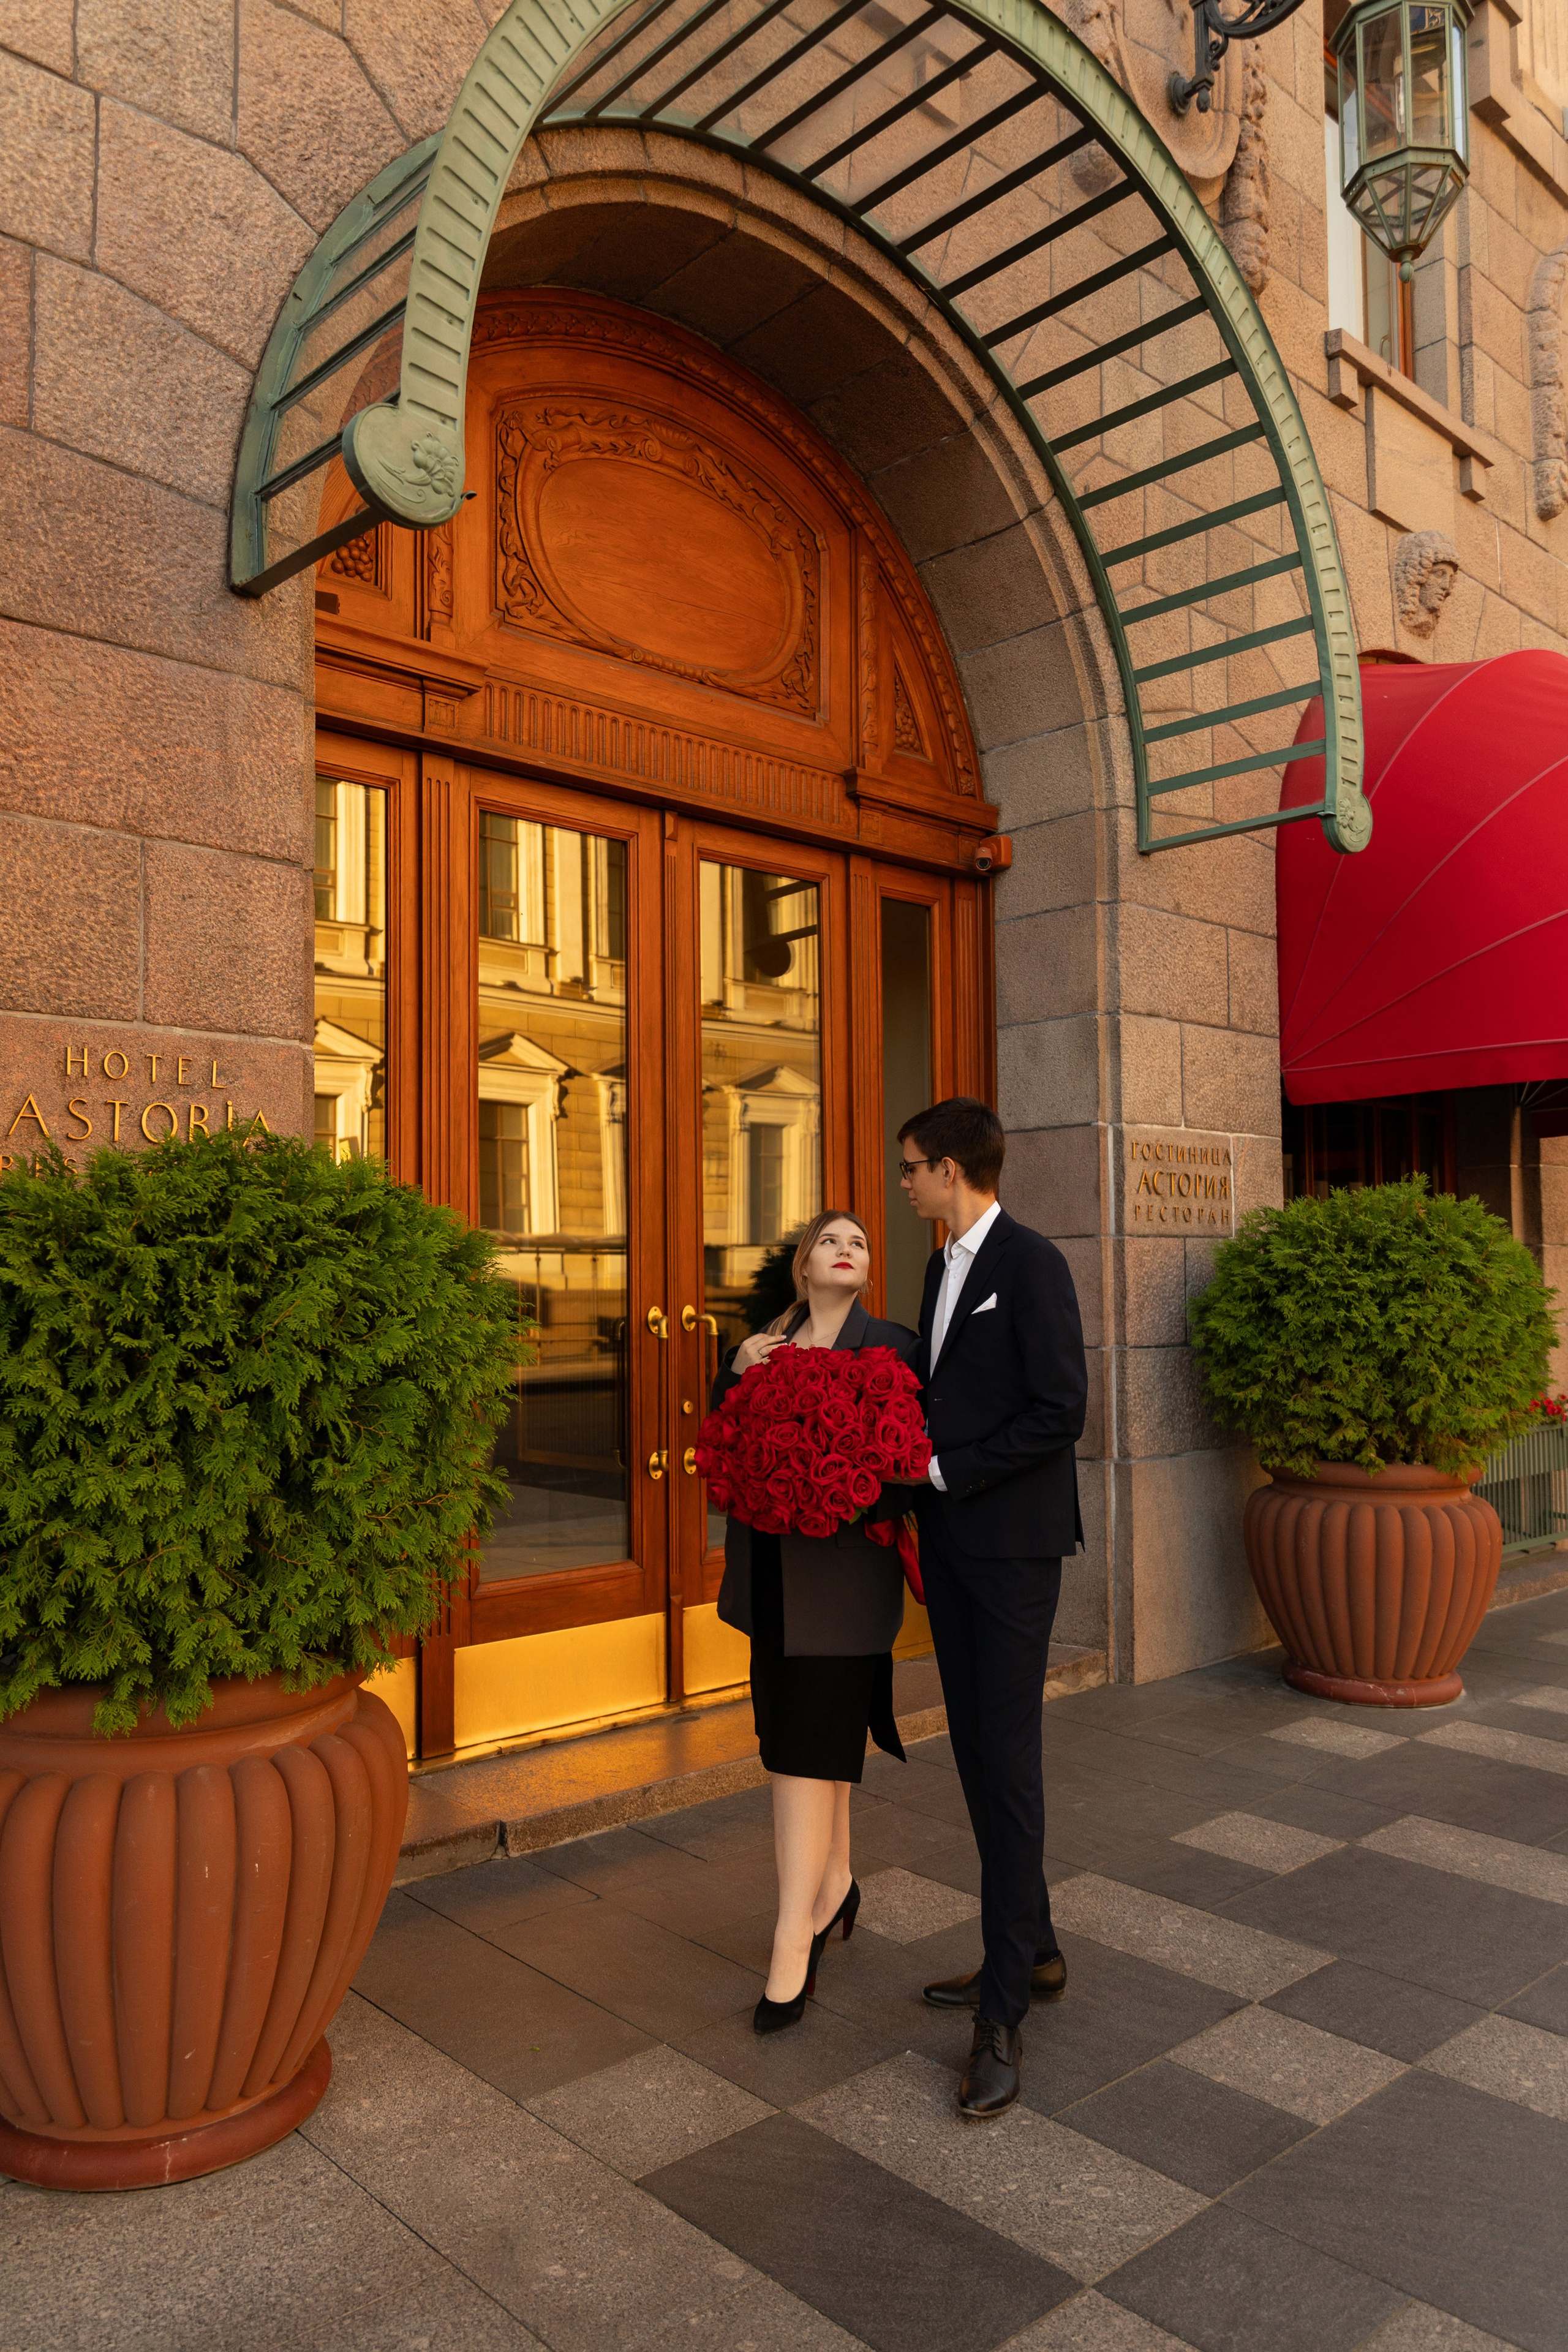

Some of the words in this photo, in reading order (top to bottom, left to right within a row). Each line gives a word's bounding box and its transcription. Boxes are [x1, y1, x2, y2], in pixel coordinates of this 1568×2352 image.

[66, 1046, 228, 1089] HOTEL
[1131, 1141, 1232, 1166] ГОСТИНИЦА
[1137, 1168, 1230, 1199] АСТОРИЯ
[1135, 1204, 1231, 1224] РЕСТОРАН
